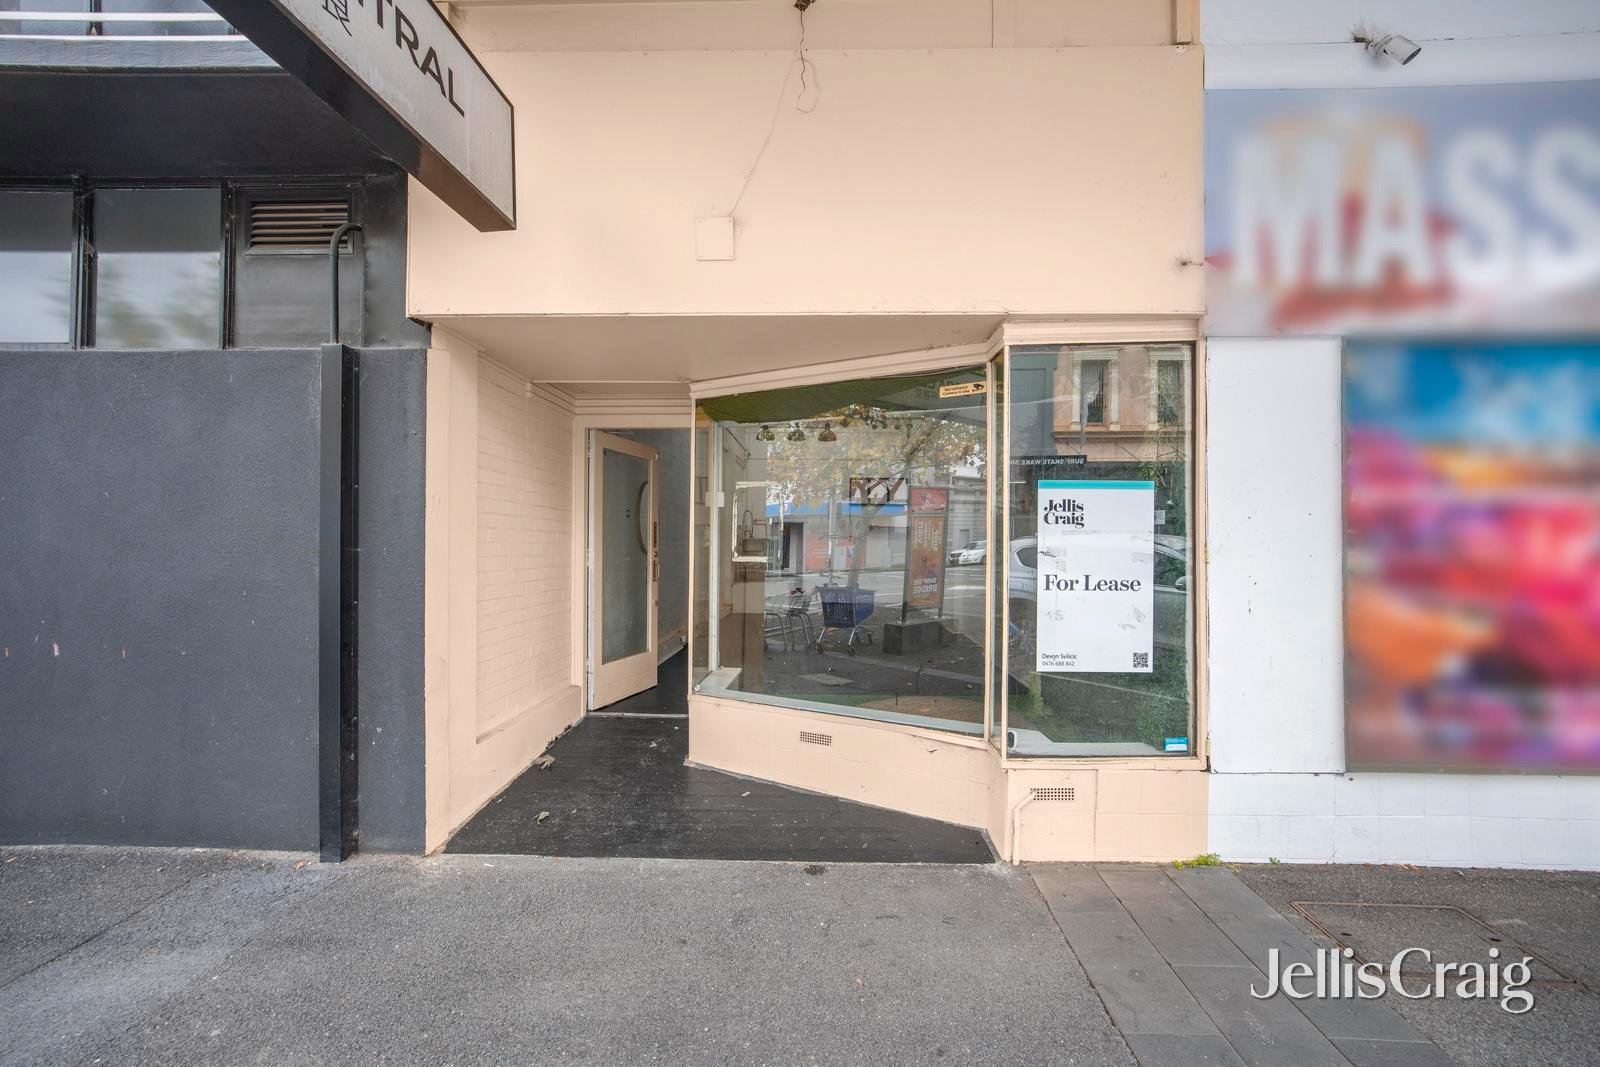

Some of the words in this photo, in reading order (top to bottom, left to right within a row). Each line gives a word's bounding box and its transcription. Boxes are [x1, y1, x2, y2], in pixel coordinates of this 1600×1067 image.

[1043, 499, 1084, 513] Jellis
[1043, 512, 1085, 529] Craig
[1044, 574, 1079, 591] For
[1083, 575, 1142, 592] Lease
